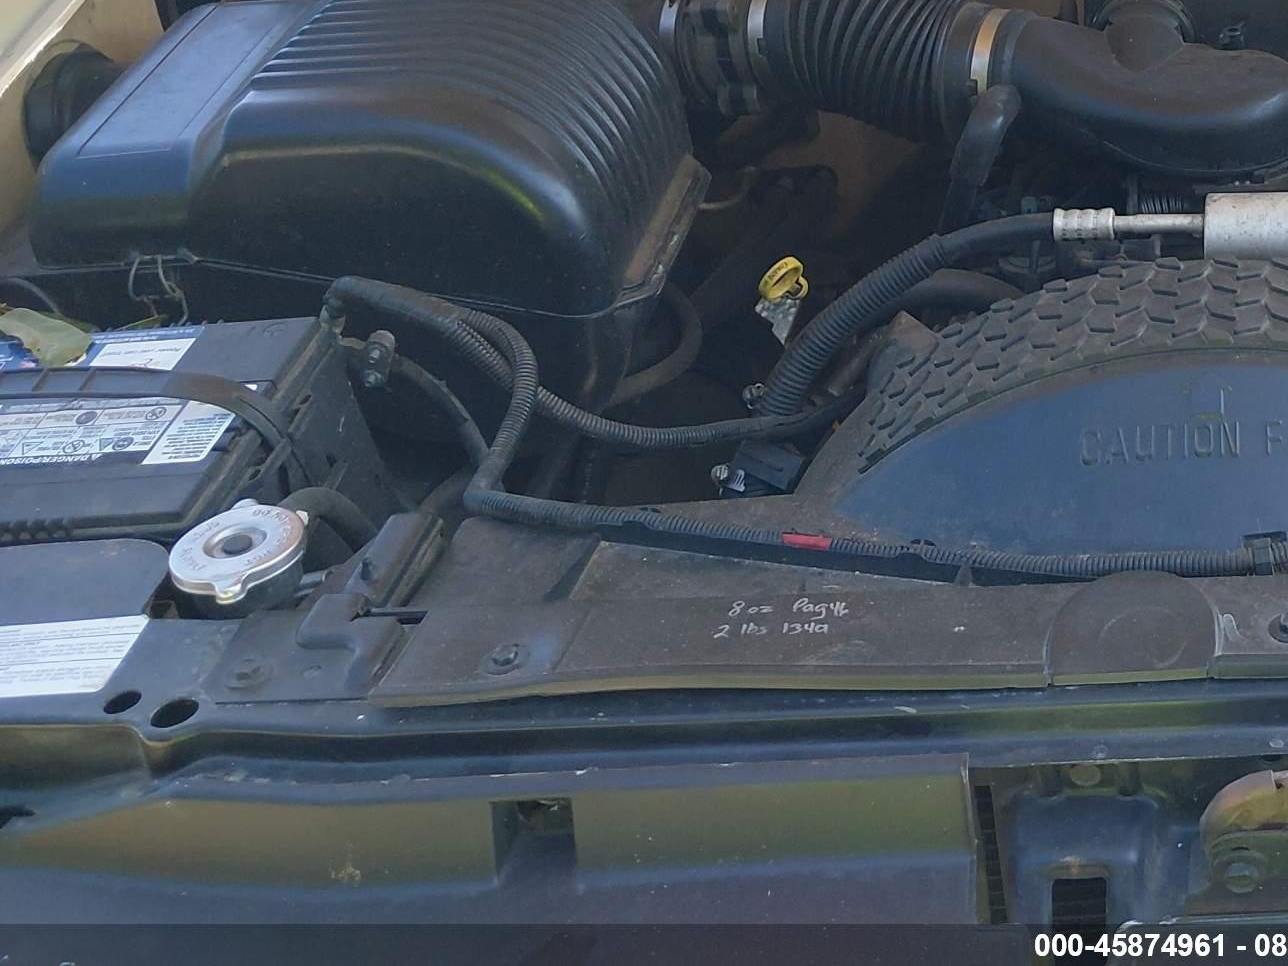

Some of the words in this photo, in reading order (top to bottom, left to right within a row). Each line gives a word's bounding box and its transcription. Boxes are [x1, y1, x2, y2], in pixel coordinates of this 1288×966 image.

[1080, 420, 1241, 467] CAUTION
[713, 624, 731, 639] 2
[740, 622, 768, 635] lbs
